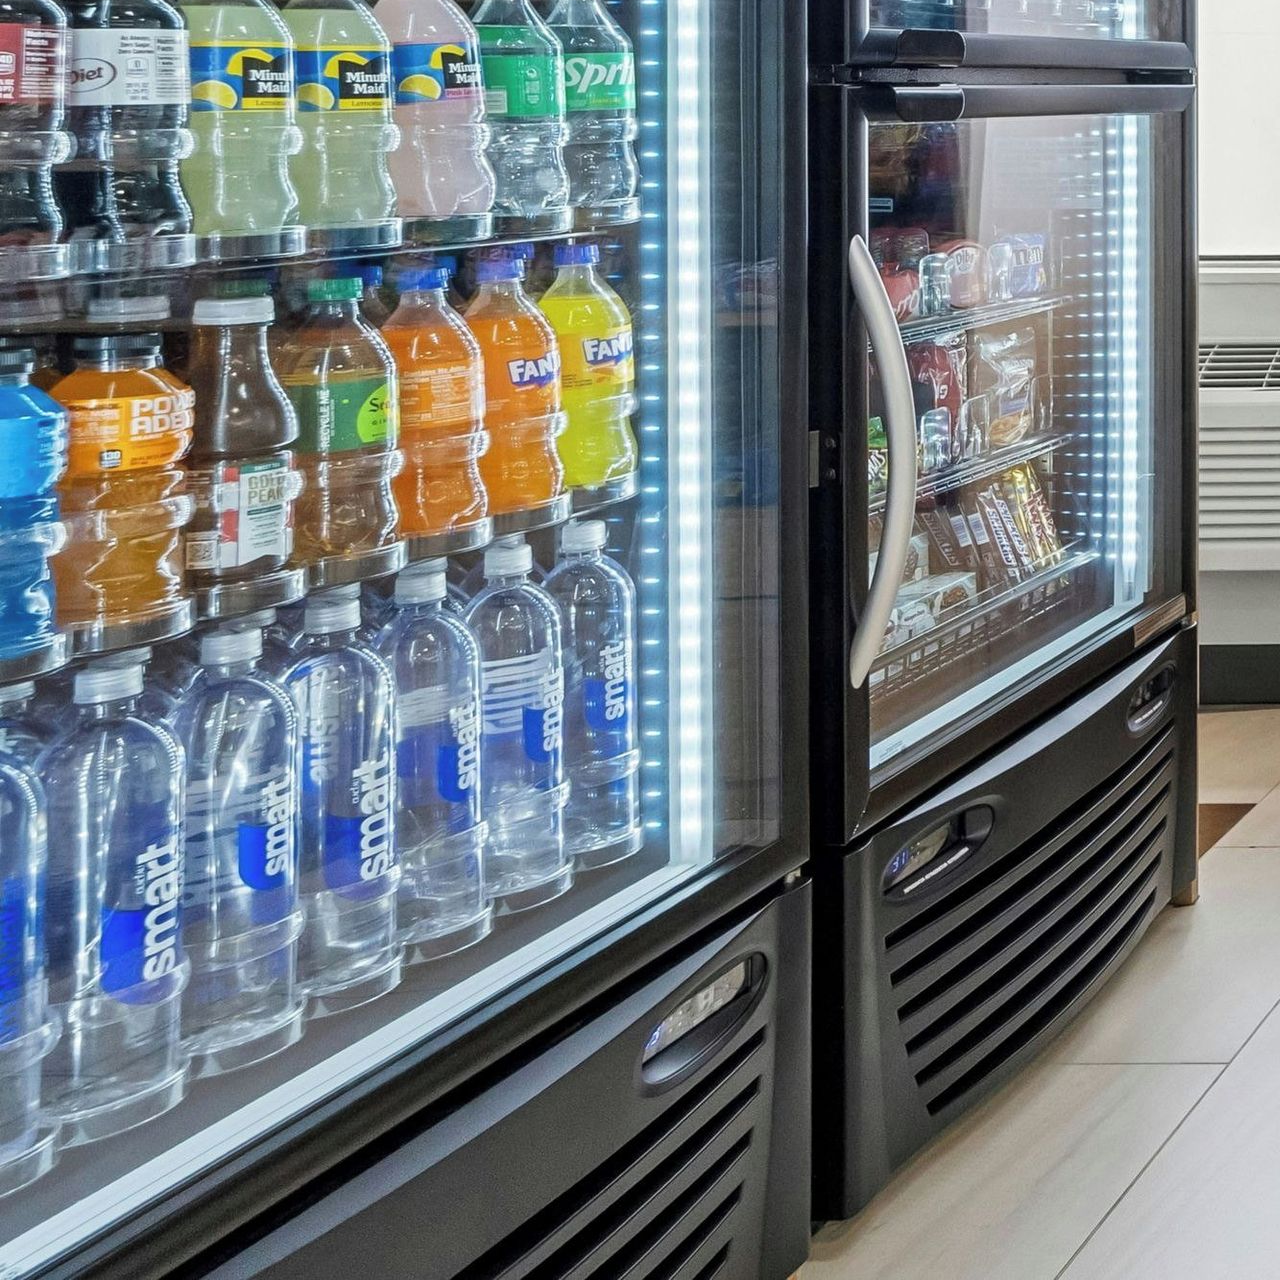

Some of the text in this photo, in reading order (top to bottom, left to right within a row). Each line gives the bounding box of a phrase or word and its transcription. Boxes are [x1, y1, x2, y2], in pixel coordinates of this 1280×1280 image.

[354, 83, 387, 95] Maid
[538, 665, 564, 752] smart
[600, 640, 625, 721] smart
[449, 700, 477, 790] smart
[262, 768, 291, 877] smart
[353, 747, 390, 880] smart
[137, 836, 179, 980] smart
